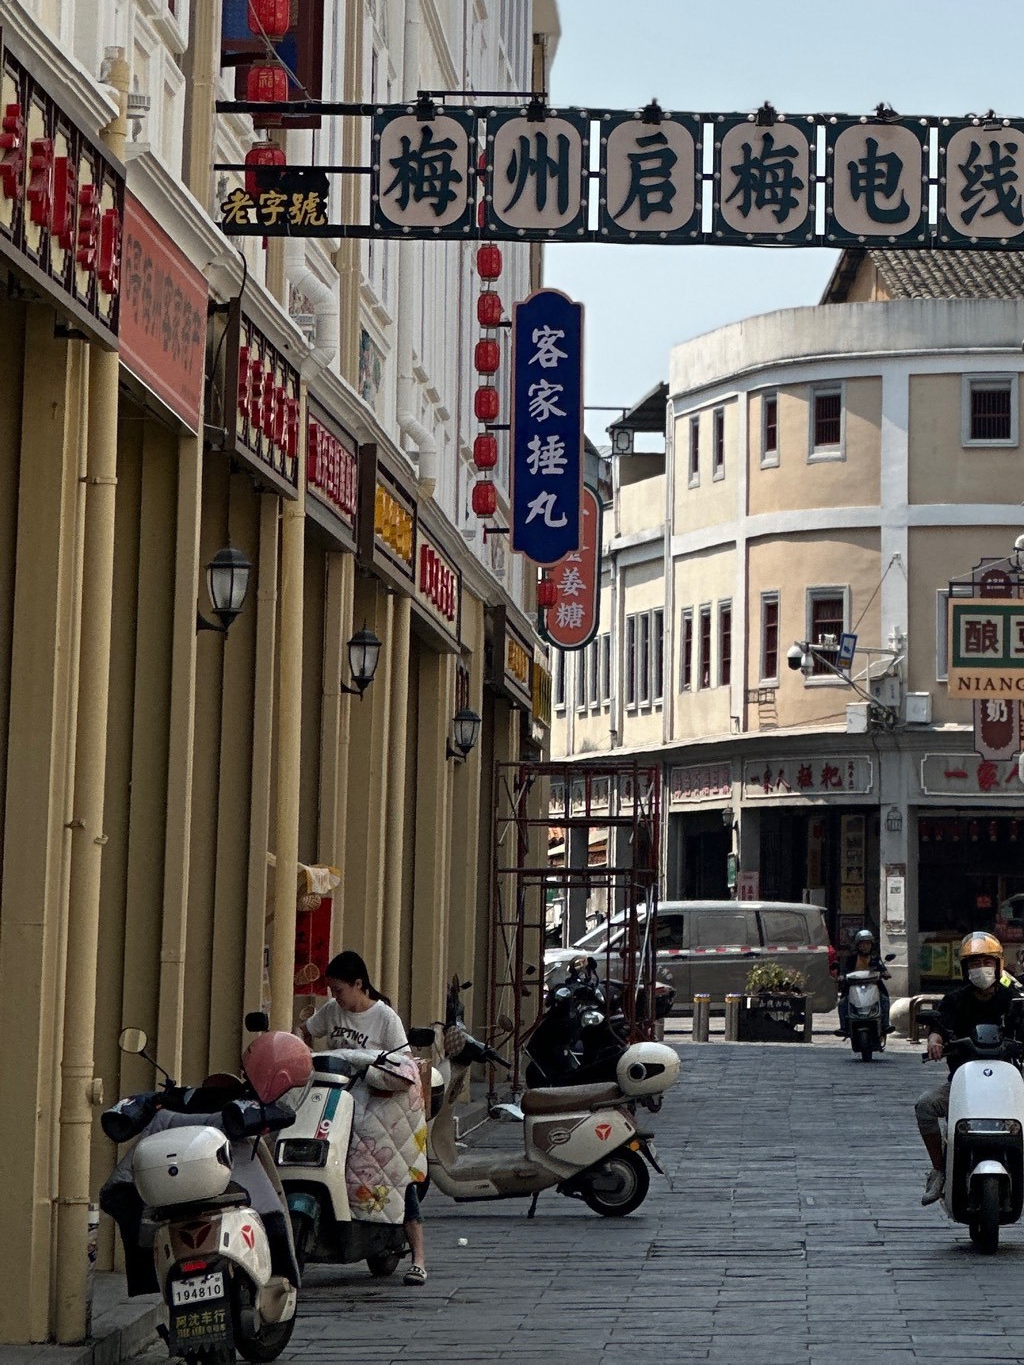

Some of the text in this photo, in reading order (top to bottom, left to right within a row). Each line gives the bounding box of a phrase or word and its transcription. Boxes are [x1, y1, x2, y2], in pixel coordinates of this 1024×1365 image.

[223, 190, 326, 226] 老字號
[525, 324, 569, 529] 客家捶丸
[176, 1284, 221, 1302] 194810
